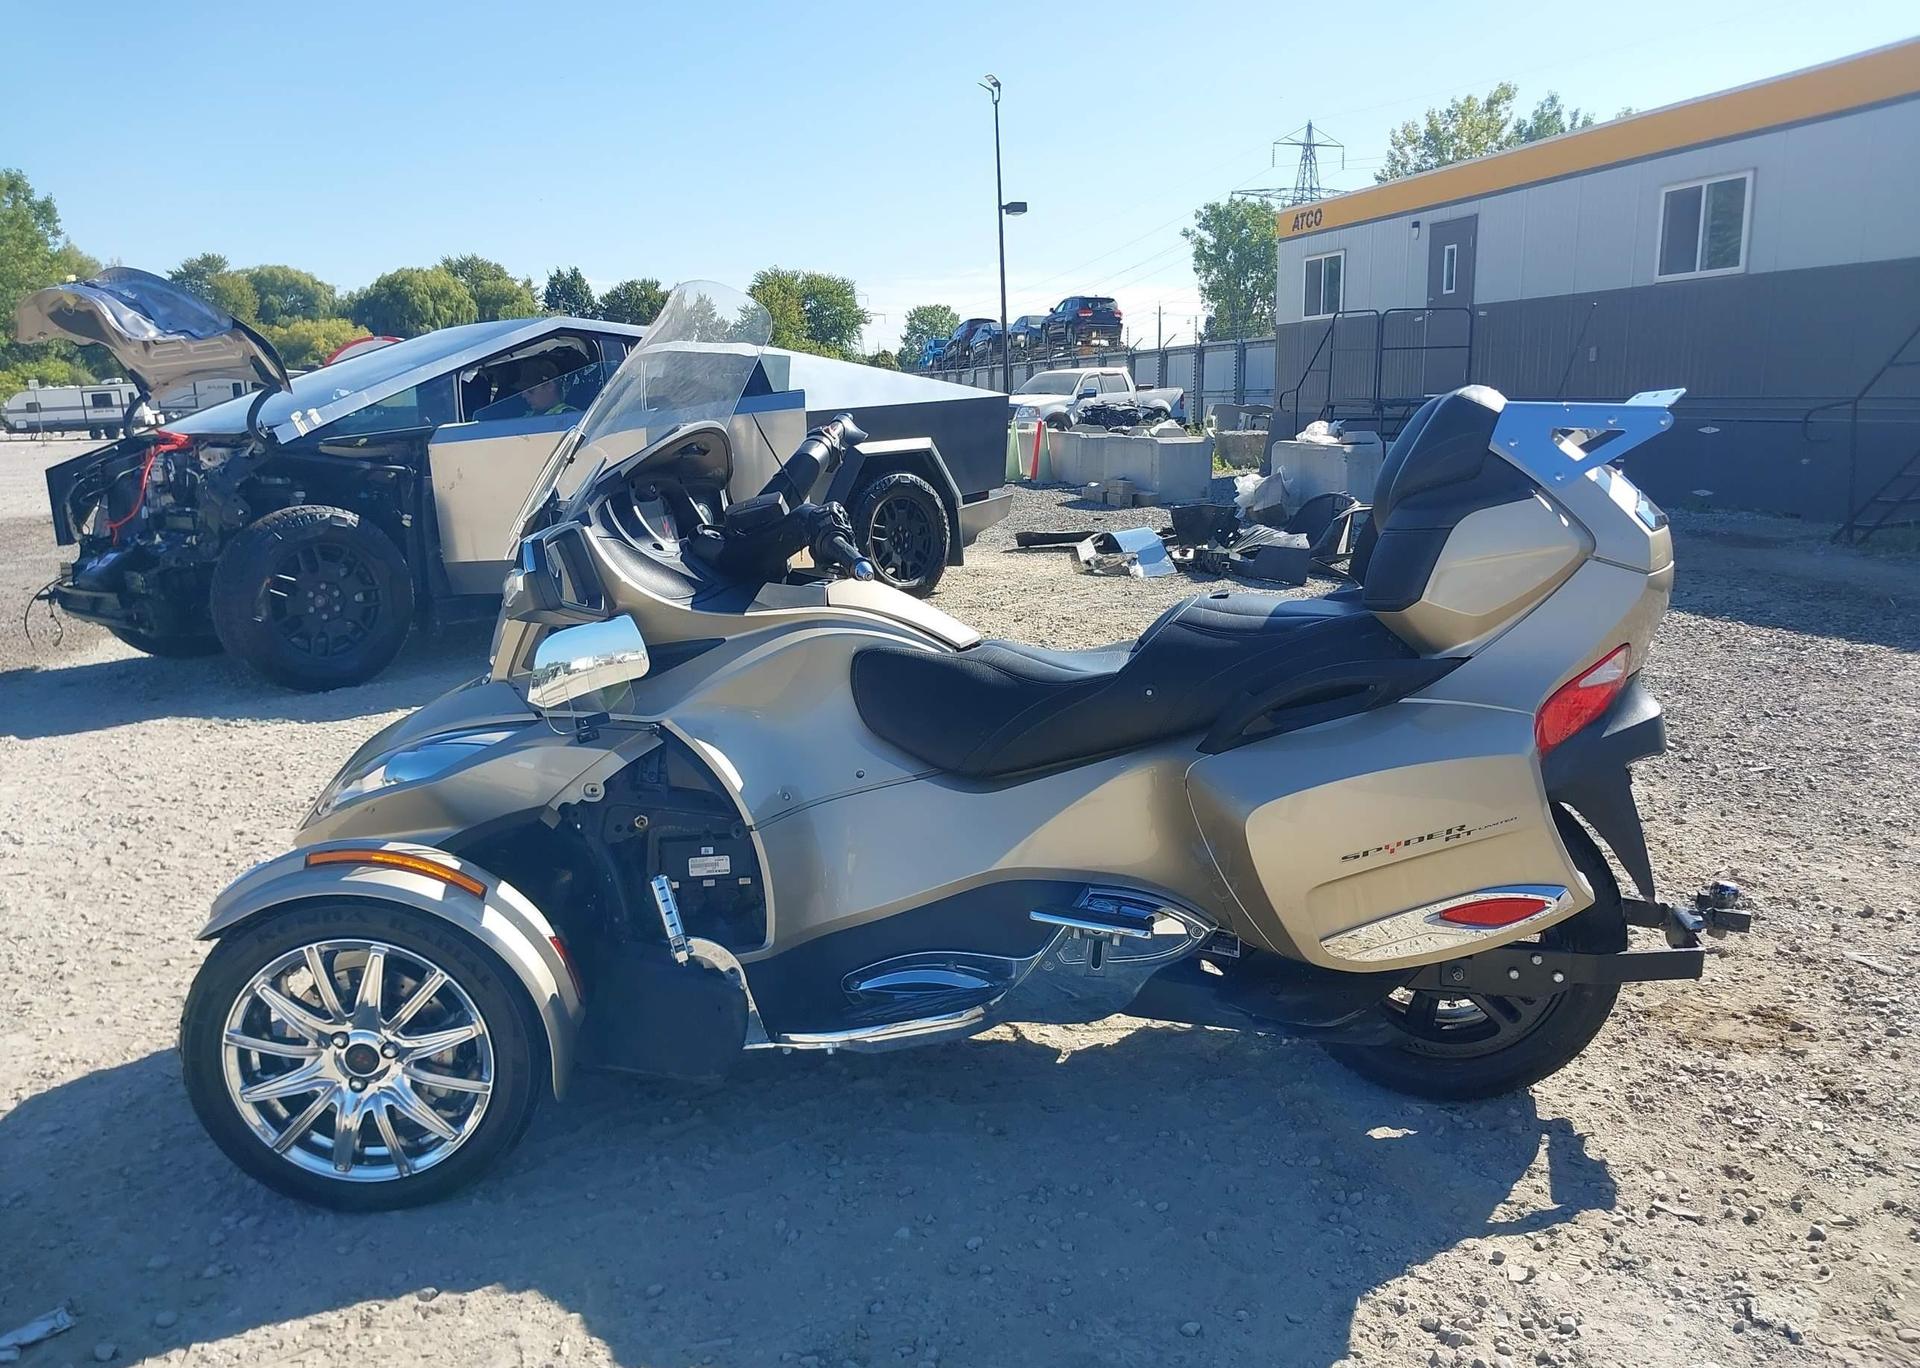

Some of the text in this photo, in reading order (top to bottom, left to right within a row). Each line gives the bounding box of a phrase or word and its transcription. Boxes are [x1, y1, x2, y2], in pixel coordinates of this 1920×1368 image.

[1292, 208, 1322, 231] ATCO
[1341, 824, 1466, 862] SPYDER
[1445, 828, 1476, 842] RT
